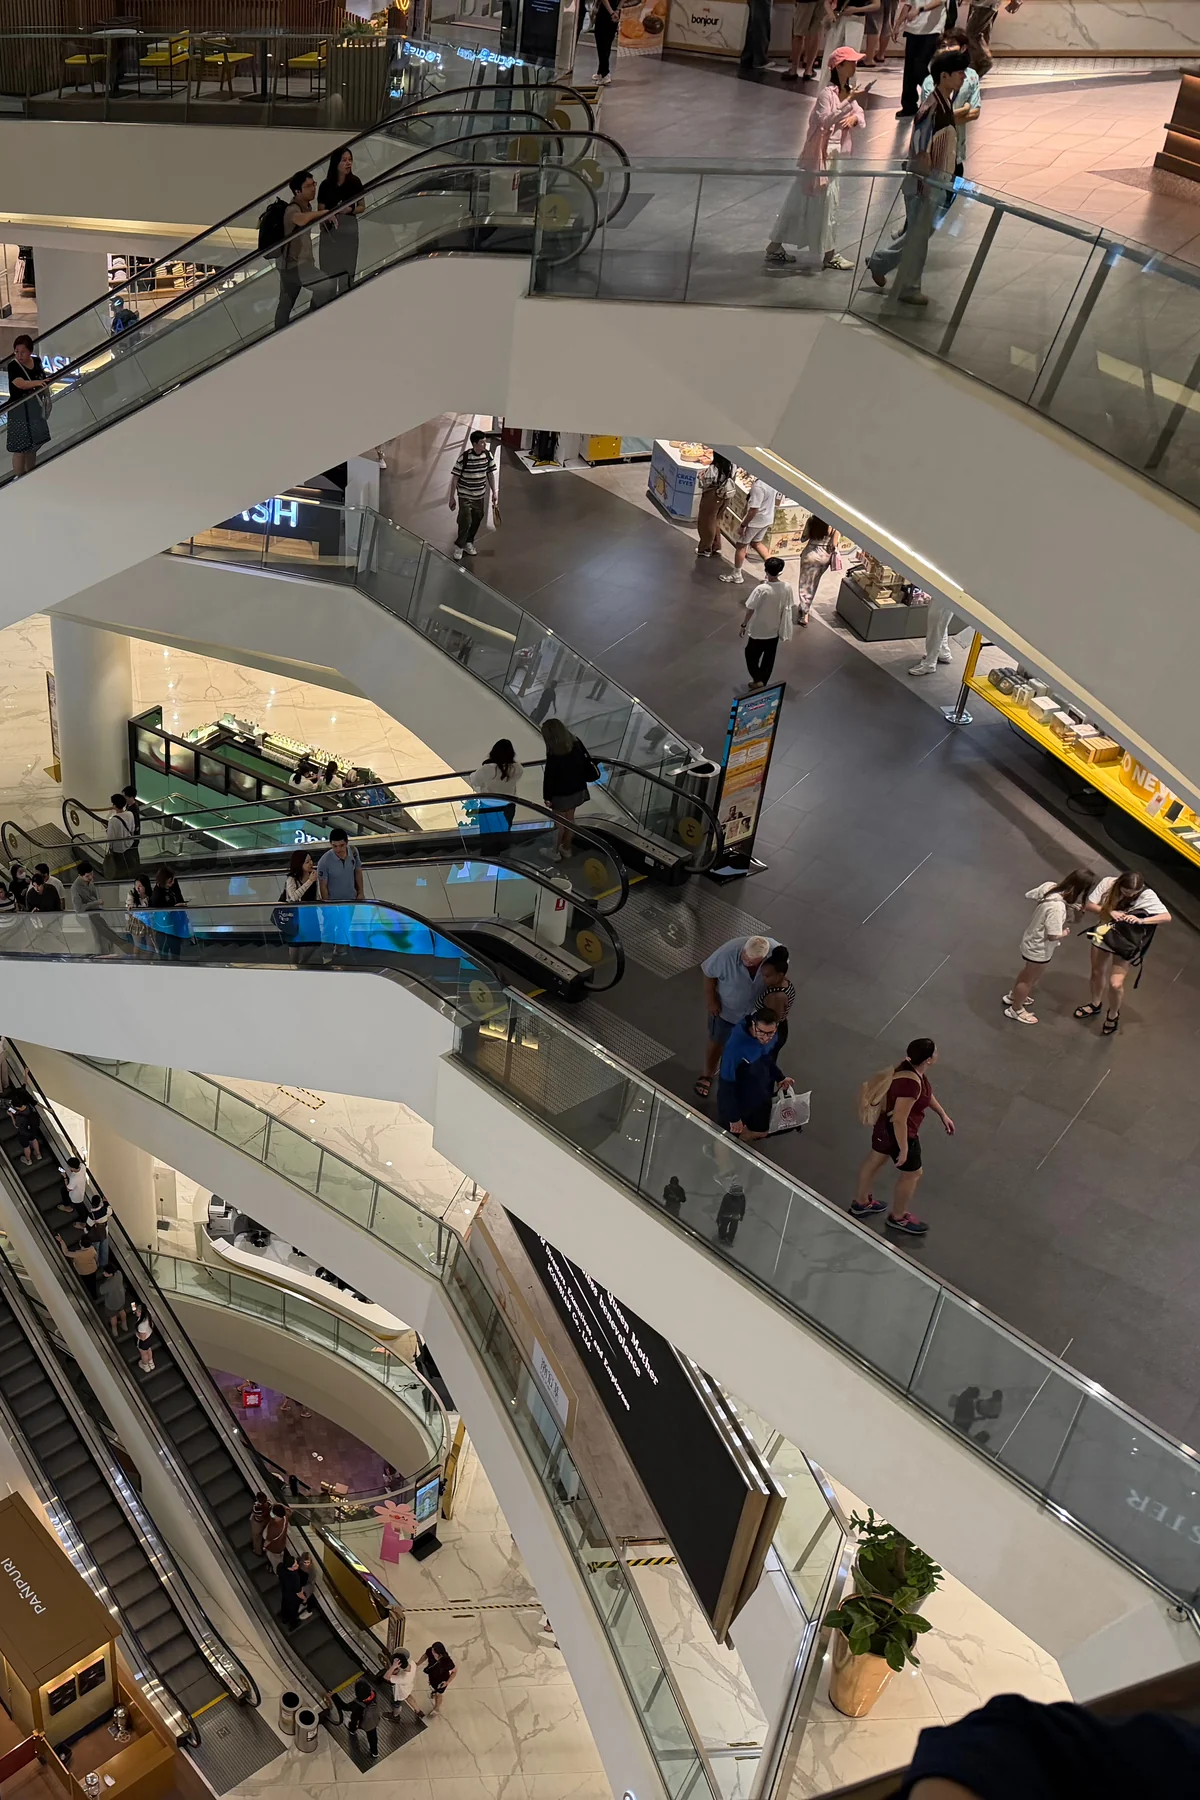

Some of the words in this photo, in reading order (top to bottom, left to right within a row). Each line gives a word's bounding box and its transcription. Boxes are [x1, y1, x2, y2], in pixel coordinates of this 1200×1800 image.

[691, 14, 720, 27] bonjour
[677, 473, 696, 481] CRAZY
[599, 1293, 642, 1378] benevolence
[606, 1289, 630, 1334] Queen
[630, 1331, 660, 1386] Mother
